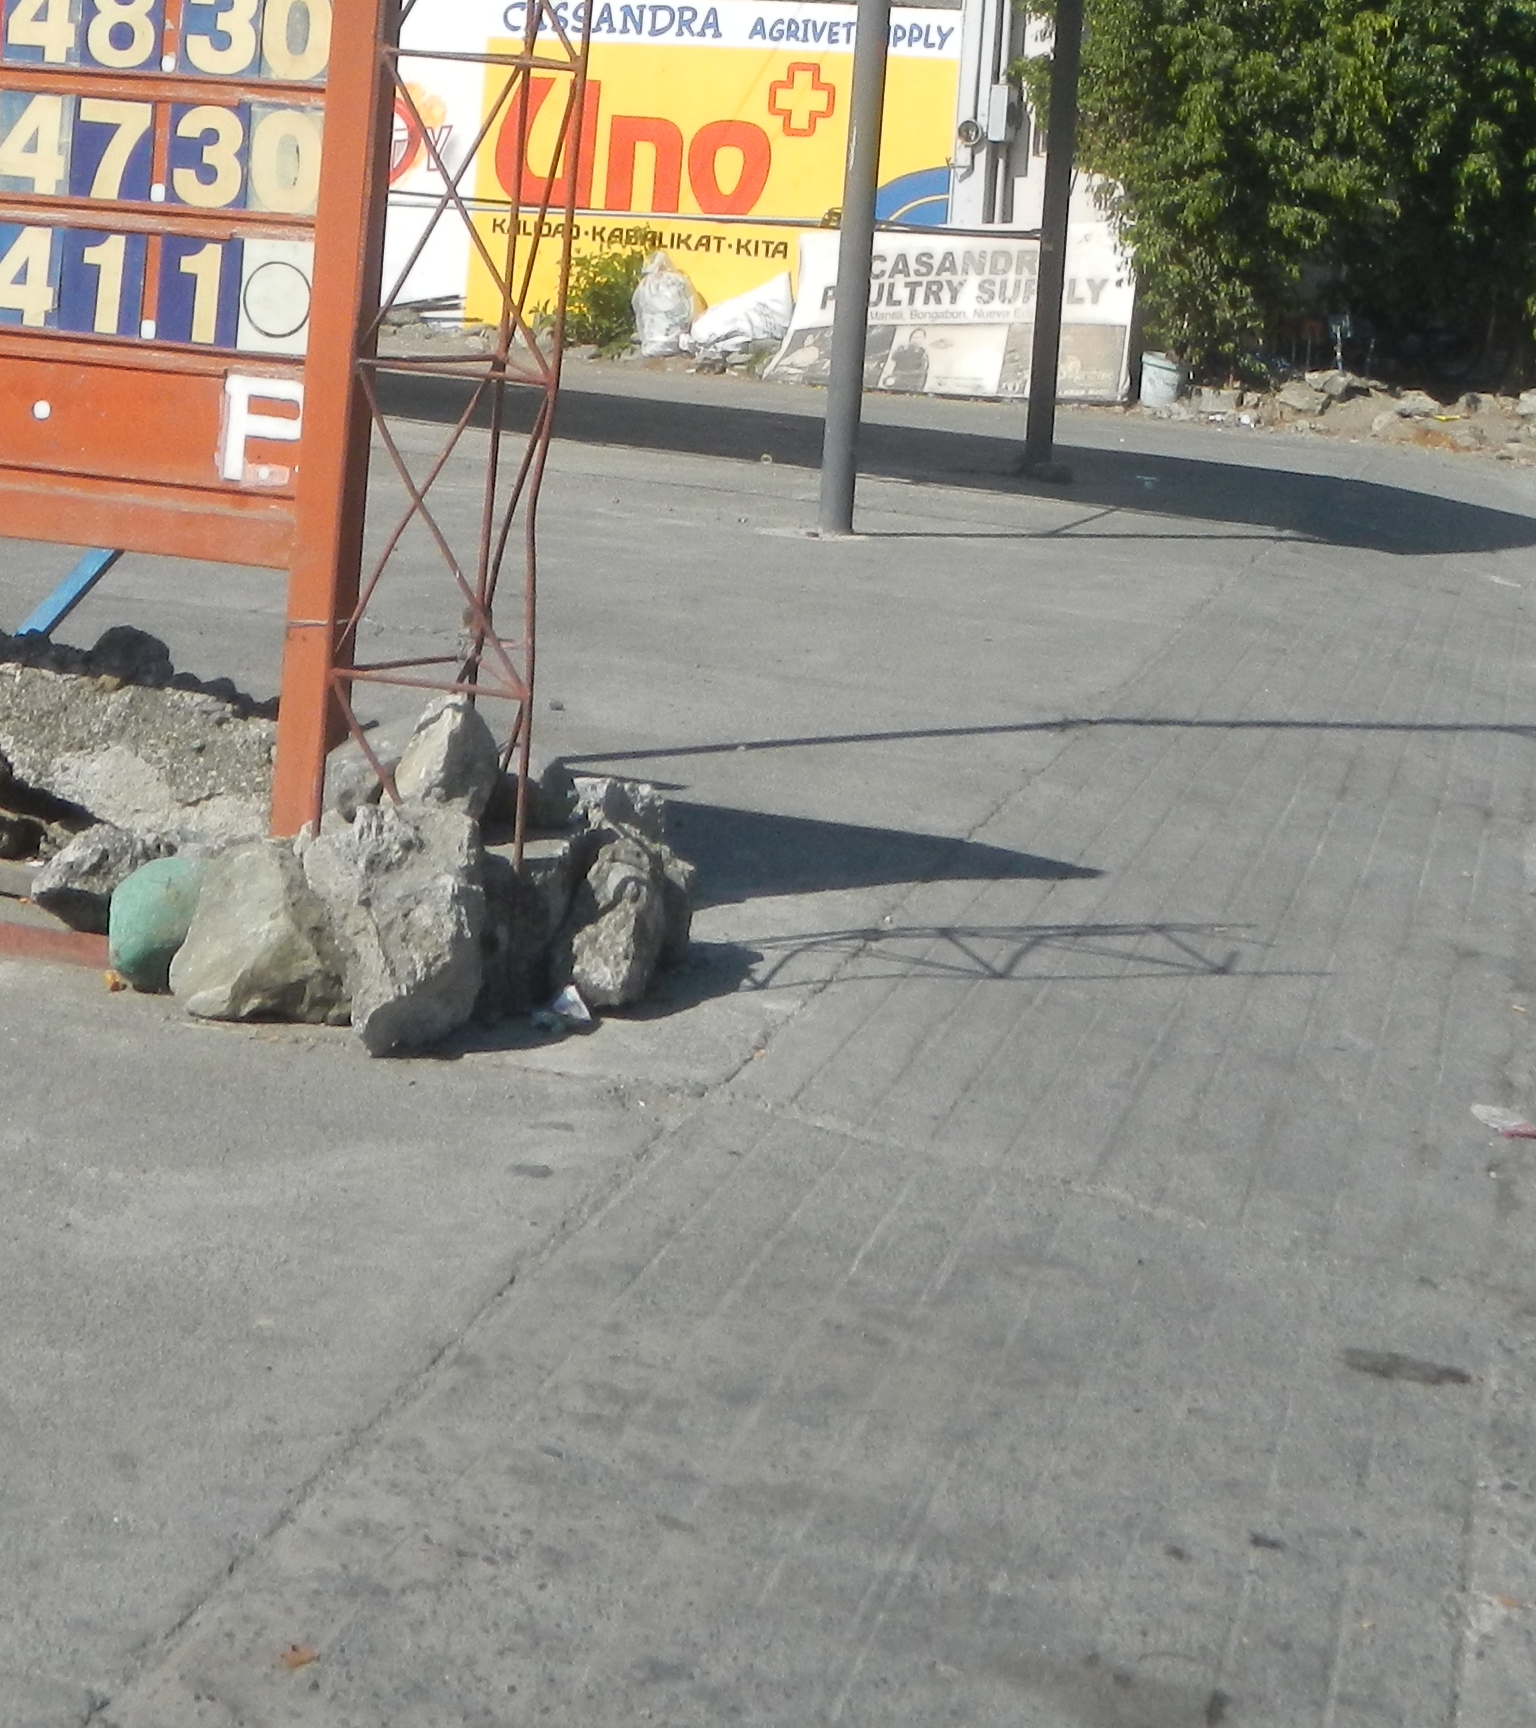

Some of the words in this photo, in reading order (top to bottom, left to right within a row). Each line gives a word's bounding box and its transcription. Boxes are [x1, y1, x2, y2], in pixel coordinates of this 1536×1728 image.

[749, 17, 855, 45] AGRIVET
[735, 237, 788, 260] KITA
[870, 250, 1038, 280] CASANDR
[820, 278, 966, 310] PULTRY
